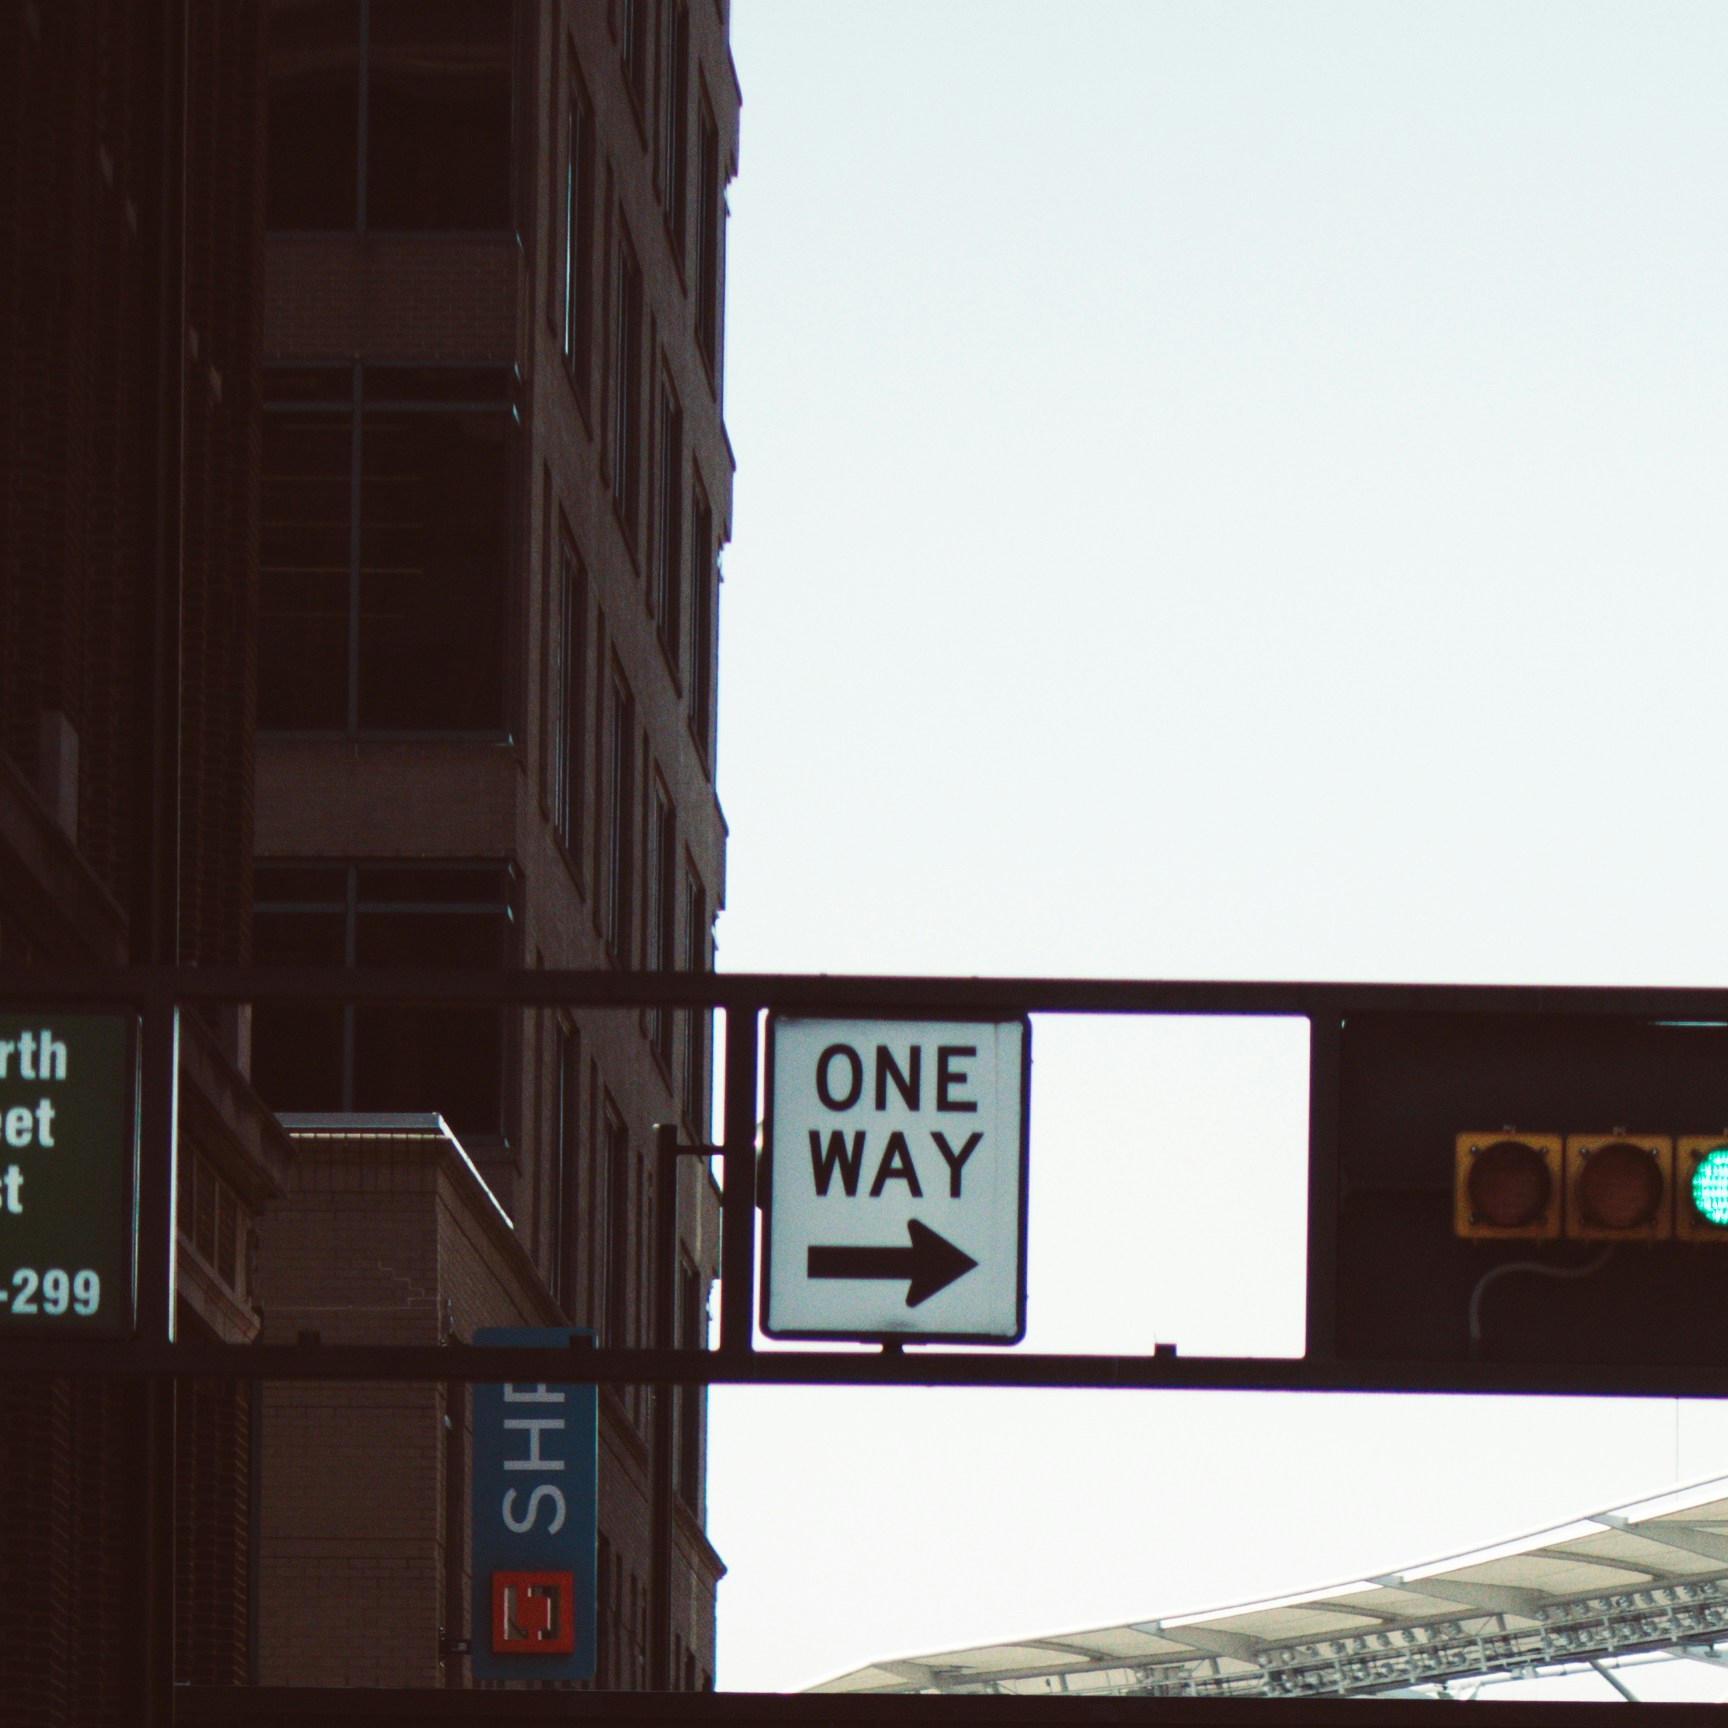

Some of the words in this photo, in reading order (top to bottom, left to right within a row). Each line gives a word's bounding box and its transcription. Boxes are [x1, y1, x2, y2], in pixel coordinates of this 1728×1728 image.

[815, 1043, 979, 1113] ONE
[0, 1098, 55, 1148] et
[808, 1129, 984, 1199] WAY
